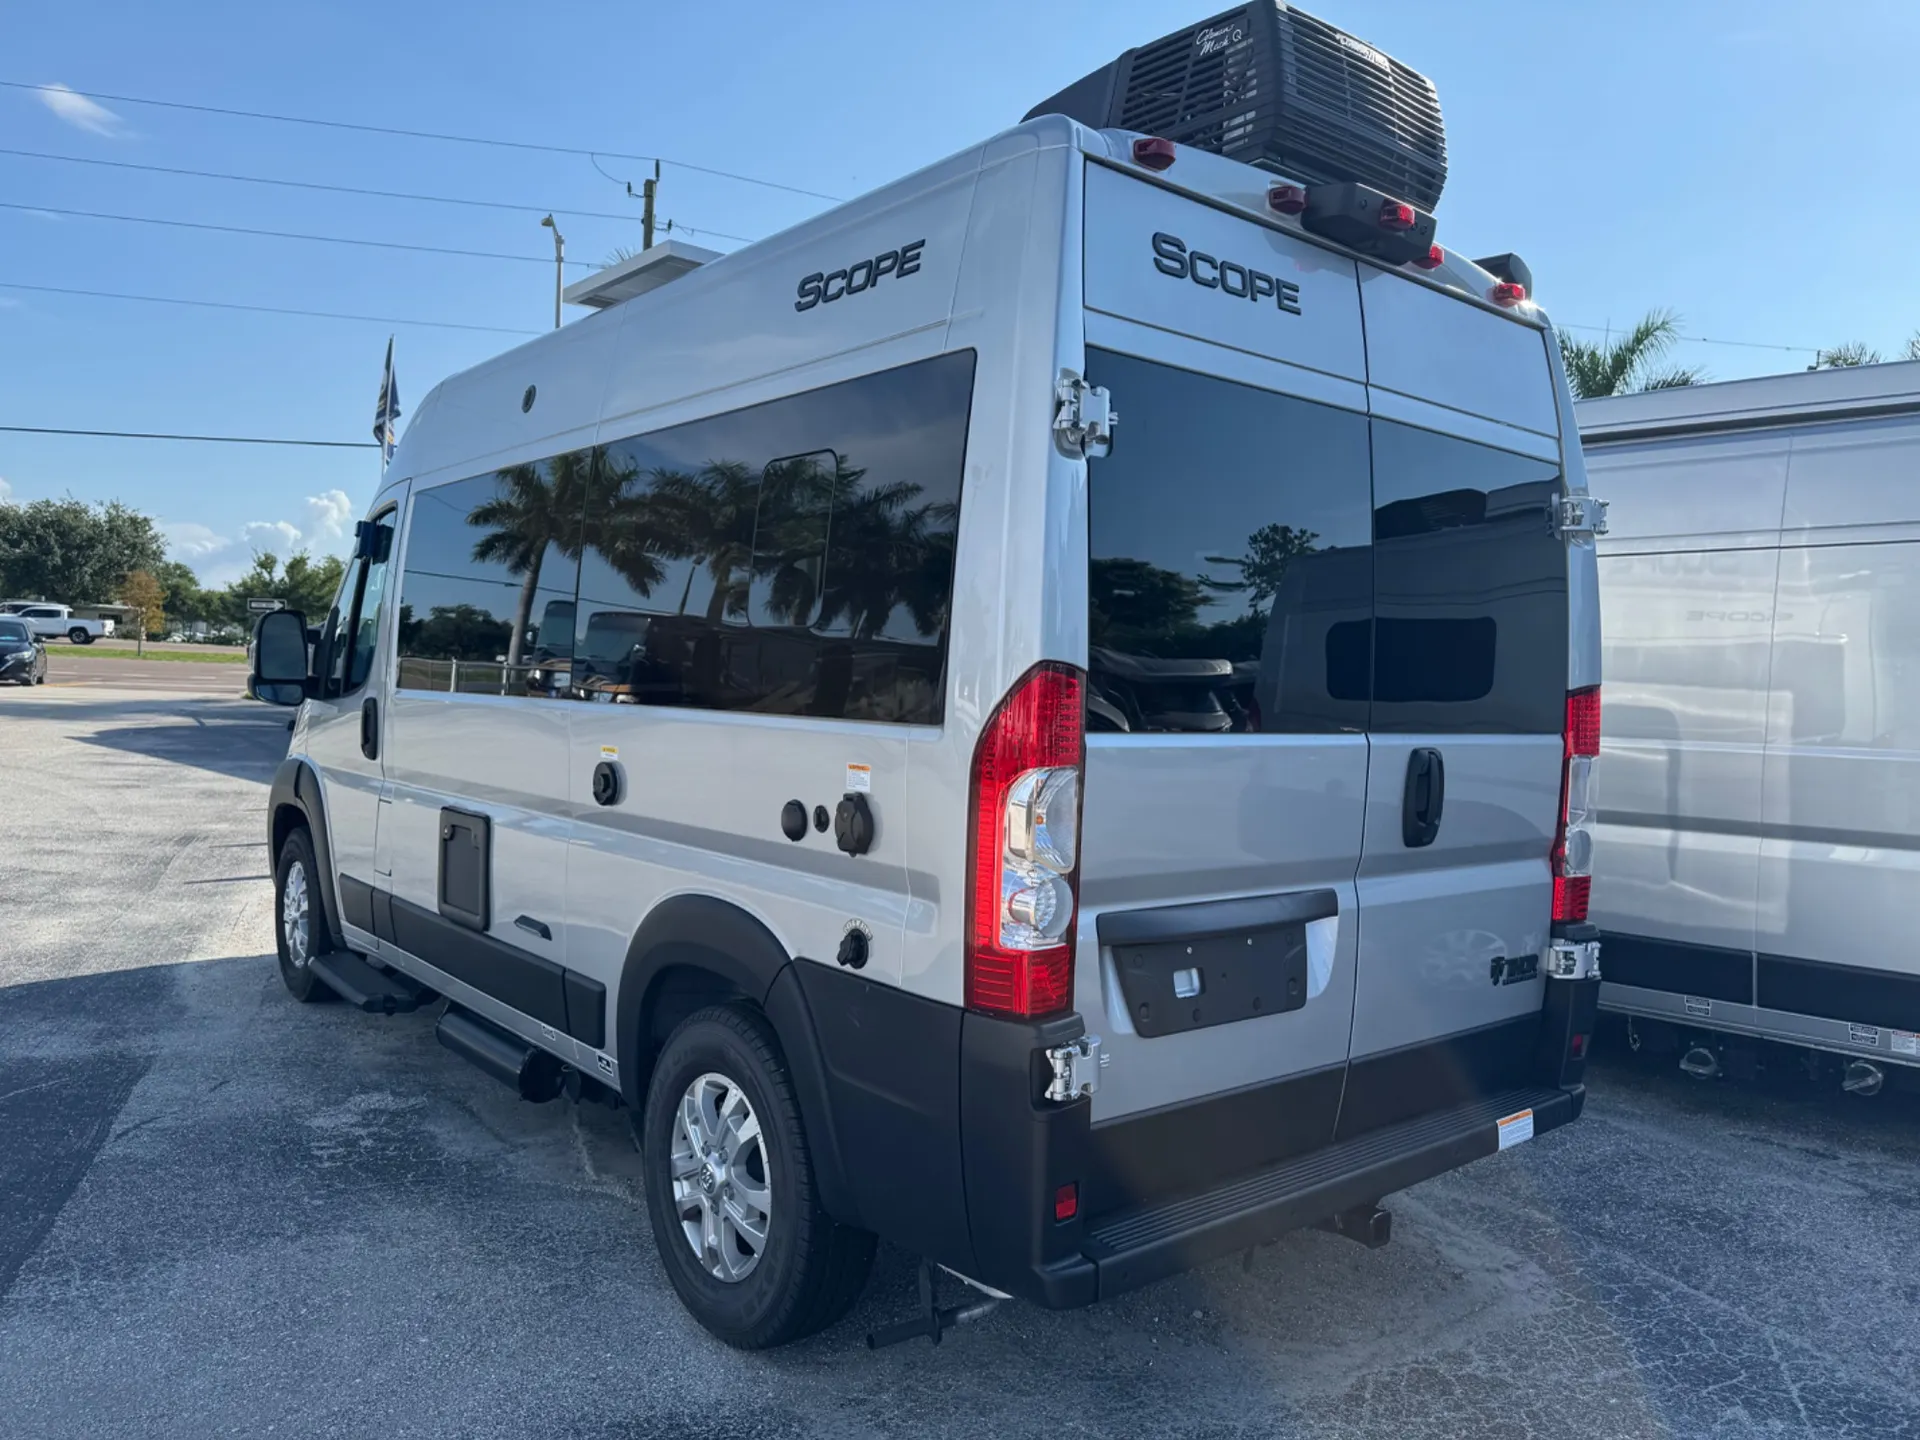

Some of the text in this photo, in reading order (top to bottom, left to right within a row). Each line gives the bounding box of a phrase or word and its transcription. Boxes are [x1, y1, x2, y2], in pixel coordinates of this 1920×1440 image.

[1232, 29, 1242, 42] Q
[794, 238, 926, 313] SCOPE
[1152, 232, 1302, 316] SCOPE
